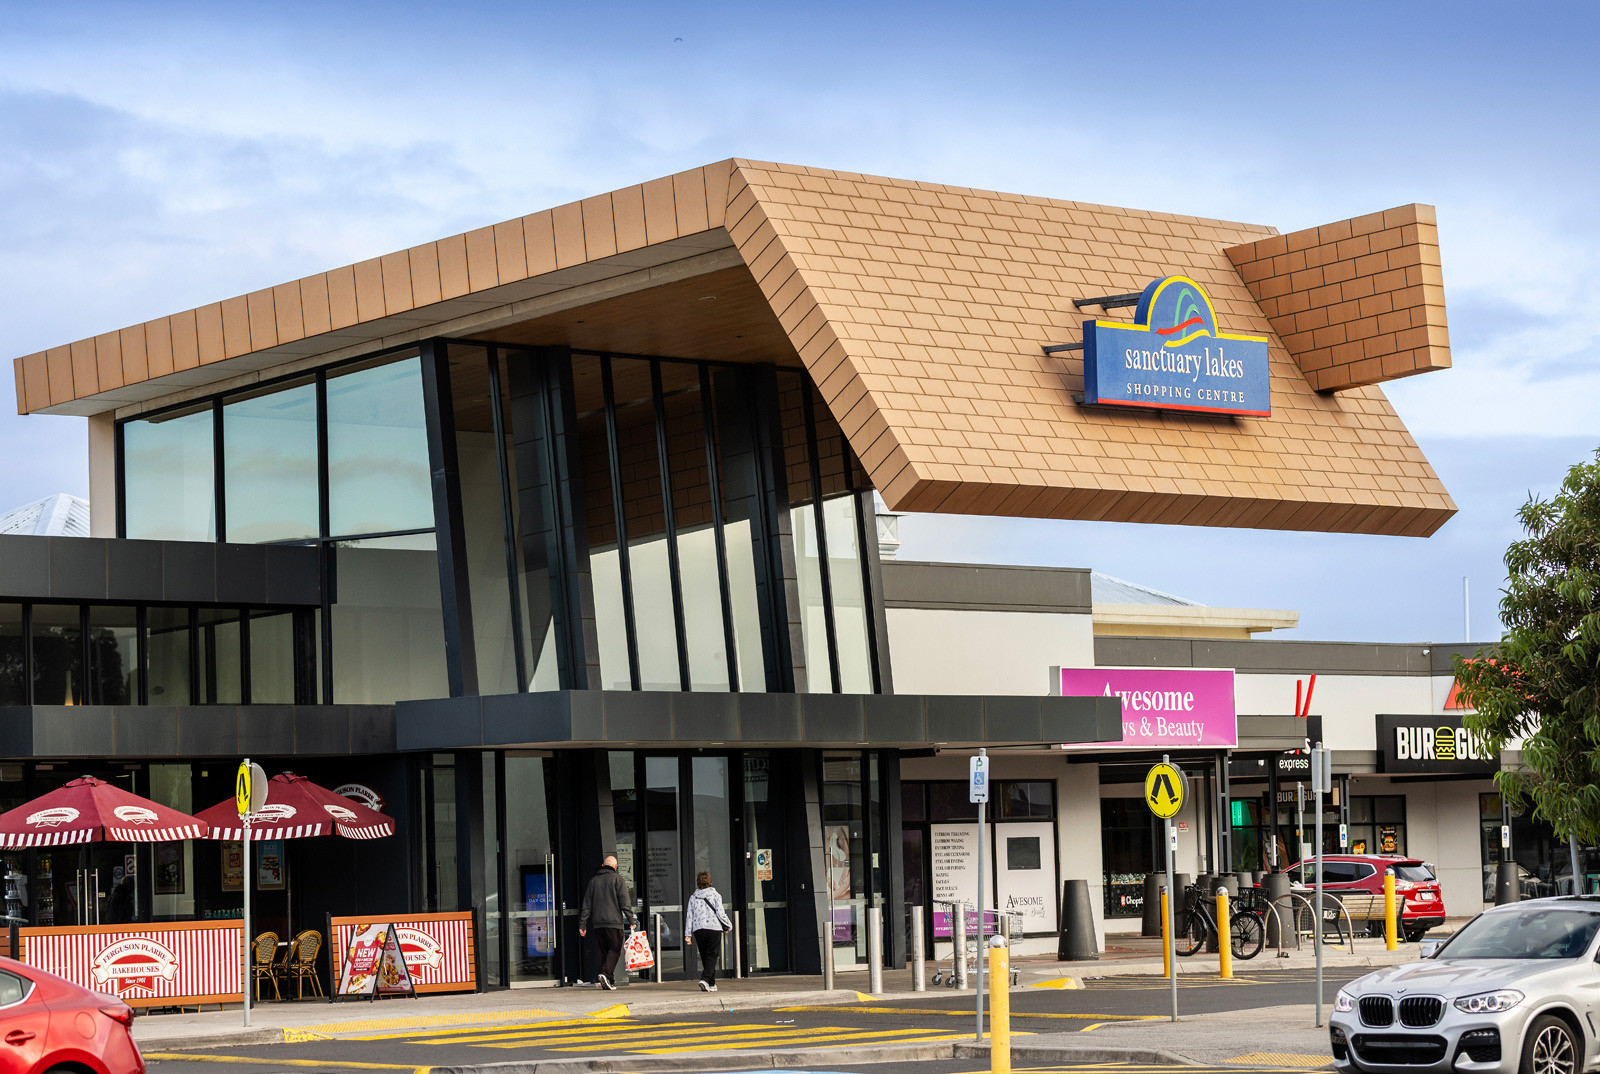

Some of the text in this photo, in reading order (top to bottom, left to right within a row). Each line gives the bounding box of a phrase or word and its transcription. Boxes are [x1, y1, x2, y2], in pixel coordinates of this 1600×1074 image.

[1125, 345, 1243, 382] sanctuary lakes
[1126, 382, 1245, 403] SHOPPING CENTRE
[1140, 716, 1153, 736] &
[1156, 717, 1204, 742] Beauty
[976, 760, 983, 771] P
[1279, 759, 1309, 771] express
[1006, 894, 1043, 908] AWESOME
[409, 933, 433, 950] PLARRE
[102, 943, 168, 964] FERGUSON PLARRE
[356, 948, 376, 957] NEW
[112, 966, 159, 974] BAKEHOUSES
